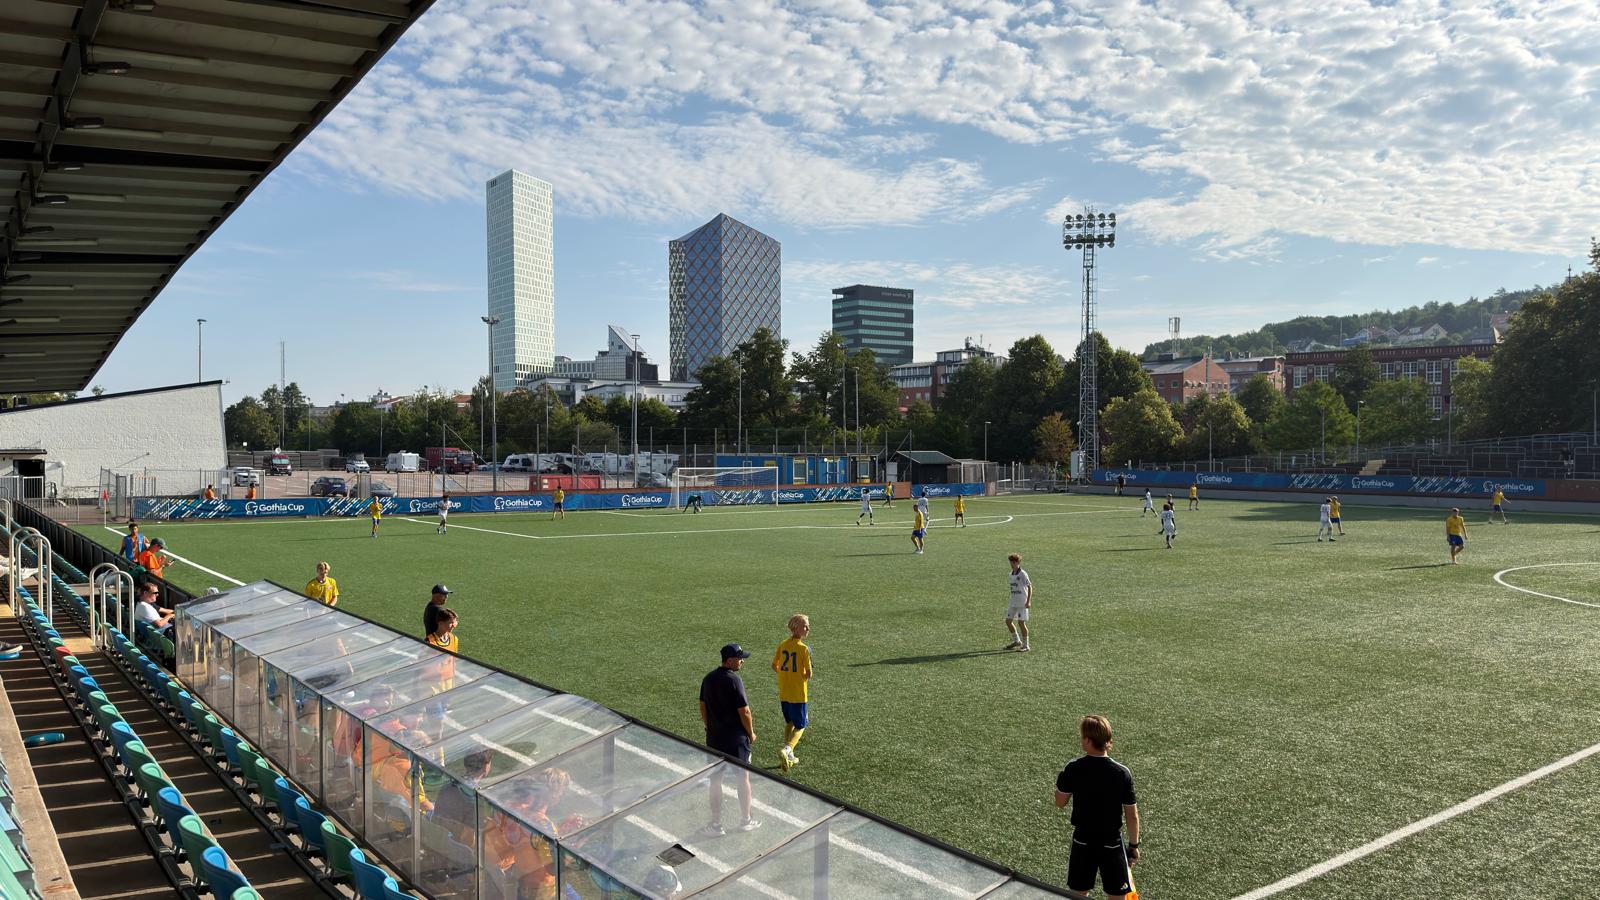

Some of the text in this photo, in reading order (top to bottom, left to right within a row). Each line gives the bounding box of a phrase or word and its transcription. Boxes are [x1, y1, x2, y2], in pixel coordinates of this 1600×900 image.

[259, 503, 304, 512] Gothia Cup
[528, 500, 542, 508] Cup
[780, 650, 797, 672] 21
